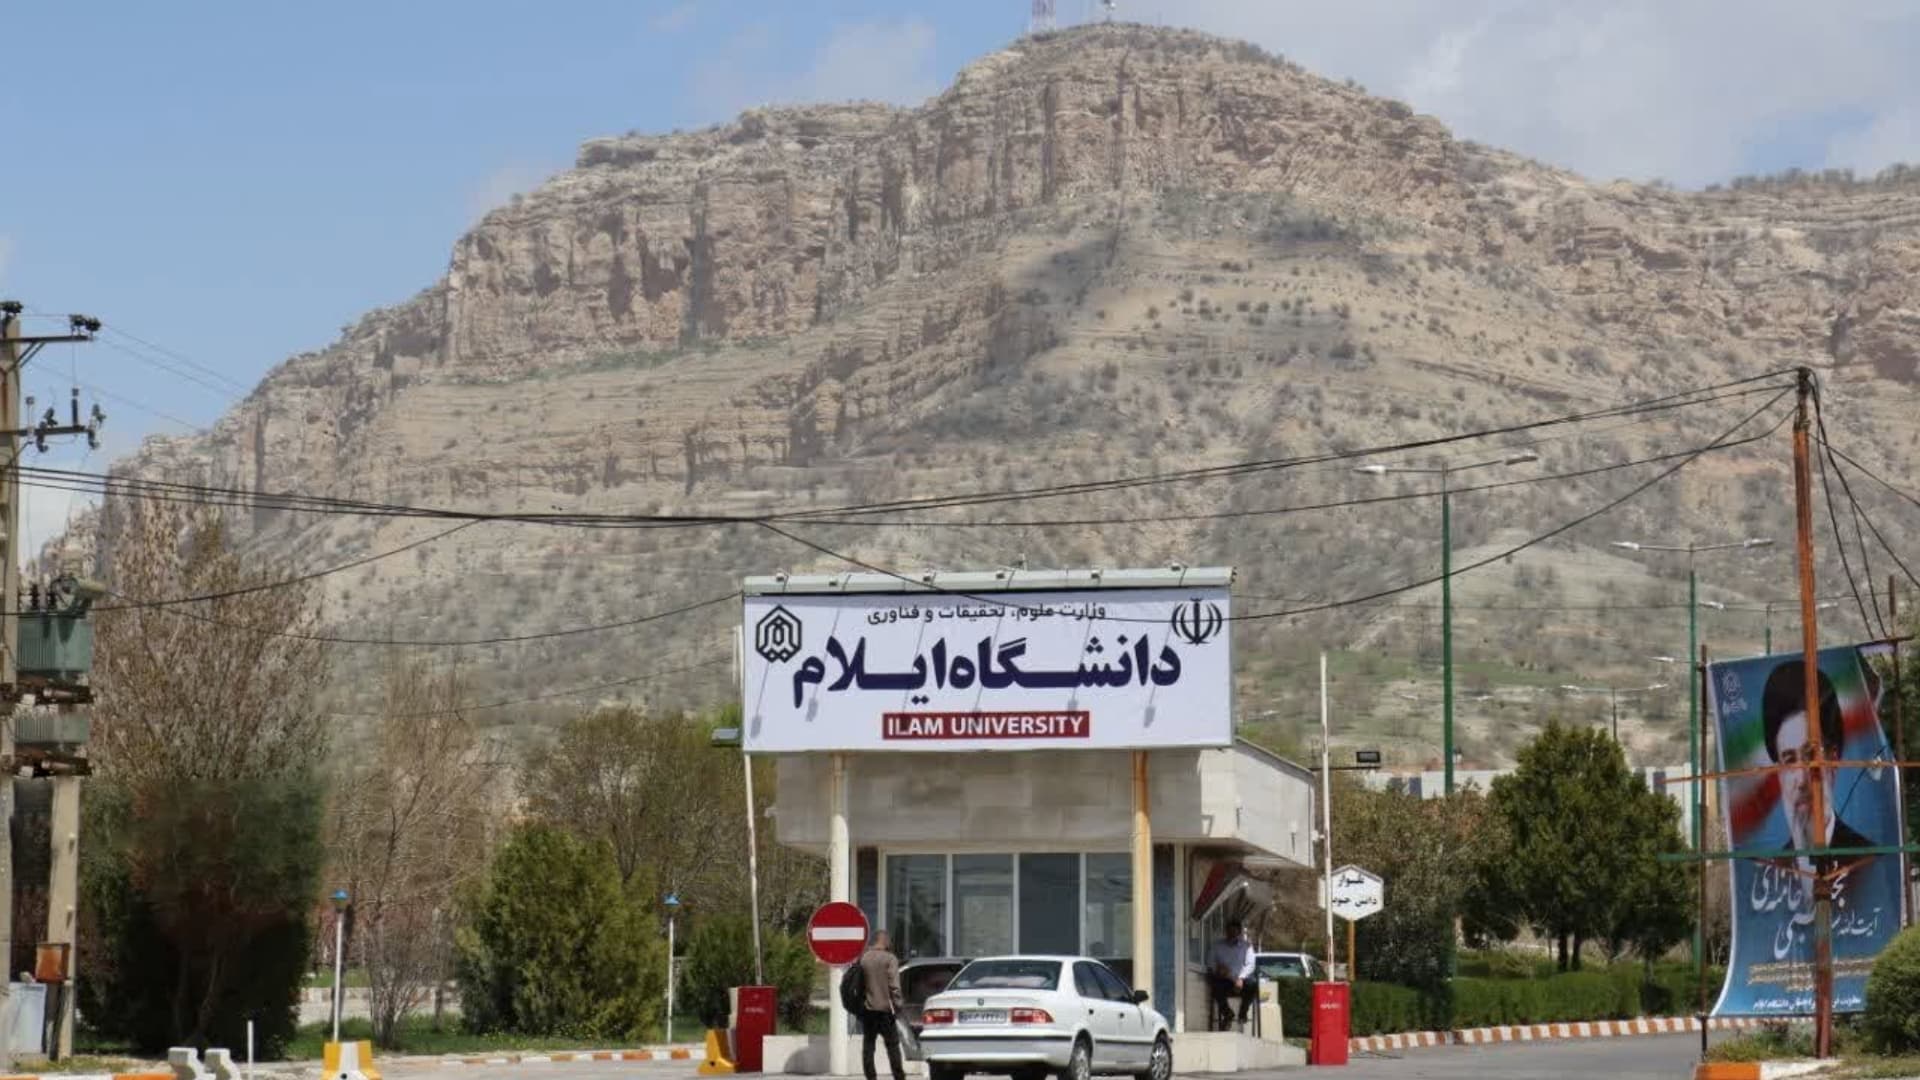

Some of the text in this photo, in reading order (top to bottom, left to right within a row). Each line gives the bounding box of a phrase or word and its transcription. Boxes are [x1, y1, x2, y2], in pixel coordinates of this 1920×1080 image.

[867, 602, 920, 625] فناوری
[924, 607, 933, 623] و
[938, 602, 1006, 622] تحقیقات
[1060, 602, 1106, 621] وزارت
[793, 633, 1182, 707] دانشگاه ایلام
[888, 716, 1084, 735] ILAM UNIVERSITY
